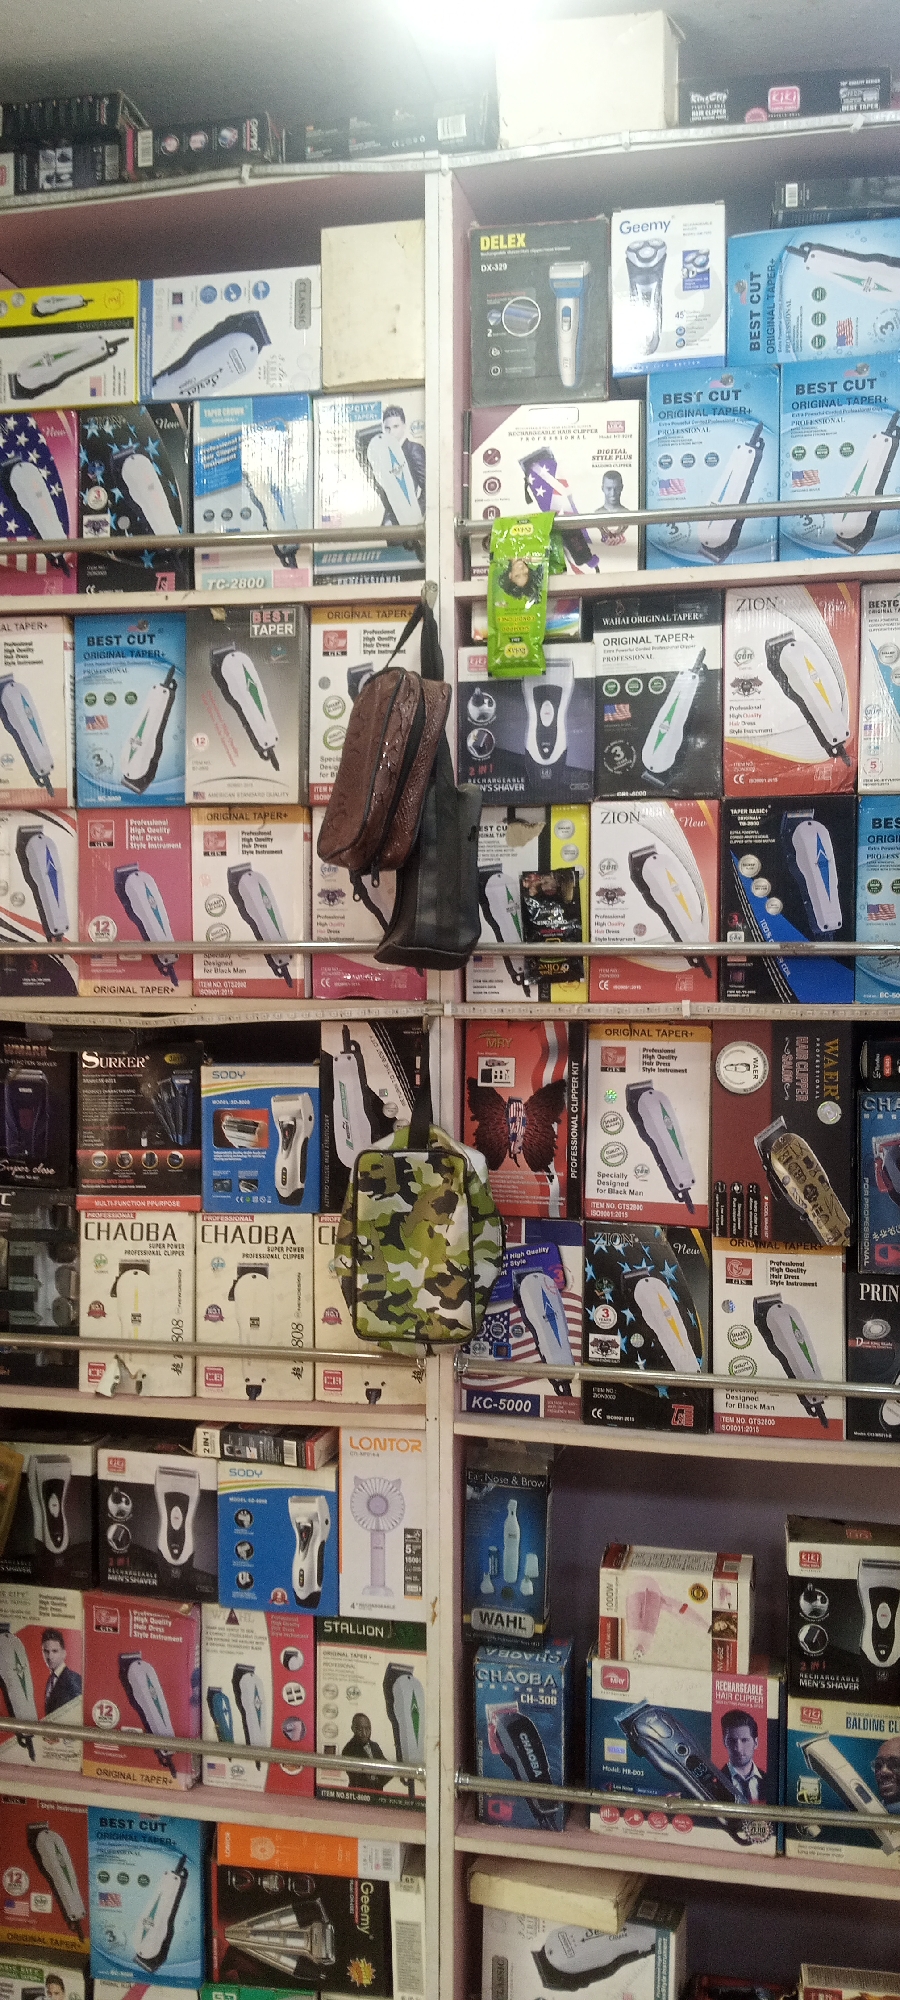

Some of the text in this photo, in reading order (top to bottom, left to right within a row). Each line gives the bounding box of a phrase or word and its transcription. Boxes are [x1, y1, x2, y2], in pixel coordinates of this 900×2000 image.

[619, 220, 671, 235] Geemy
[480, 233, 526, 250] DELEX
[481, 263, 507, 272] DX-329
[750, 272, 761, 351] BEST CUT
[767, 259, 775, 354] ORIGINAL TAPER+
[795, 378, 877, 396] BEST CUT
[662, 389, 742, 405] BEST CUT
[791, 395, 888, 410] ORIGINAL TAPER+
[658, 406, 753, 420] ORIGINAL TAPER+
[155, 418, 180, 430] New
[791, 417, 846, 426] PROFESSIONAL
[322, 551, 382, 564] HIGH QUALITY
[206, 577, 265, 589] TC-2800
[736, 597, 778, 611] ZION
[252, 610, 291, 623] BEST
[327, 609, 414, 620] ORIGINAL TAPER+
[630, 615, 671, 624] ORIGINAL
[15, 622, 48, 631] TAPER+
[252, 624, 294, 636] TAPER
[87, 633, 156, 647] BEST CUT
[602, 633, 695, 647] ORIGINAL TAPER+
[83, 652, 126, 660] ORIGINAL
[602, 654, 654, 663] PROFESSIONAL
[206, 812, 288, 821] ORIGINAL TAPER+
[600, 811, 641, 825] ZION
[679, 816, 708, 828] New
[93, 920, 110, 932] 12
[203, 959, 233, 967] Designed
[93, 986, 175, 994] ORIGINAL TAPER+
[605, 1028, 694, 1038] ORIGINAL TAPER+
[486, 1037, 513, 1048] MRY
[82, 1051, 145, 1069] SURKER
[571, 1061, 579, 1079] KIT
[796, 1036, 809, 1101] HAIR CLIPPER
[823, 1038, 839, 1098] WAER
[212, 1070, 246, 1080] SODY
[571, 1080, 579, 1112] CLIPPER
[597, 1171, 628, 1180] Specially
[597, 1179, 629, 1188] Designed
[607, 1188, 627, 1196] Black
[85, 1222, 177, 1242] CHAOBA
[201, 1225, 297, 1245] CHAOBA
[593, 1232, 636, 1247] ZION
[509, 1247, 550, 1260] High Quality
[673, 1243, 701, 1255] New
[508, 1259, 526, 1267] Style
[769, 1266, 784, 1274] High
[860, 1283, 899, 1302] PRIN
[601, 1308, 610, 1319] 3
[472, 1396, 531, 1413] KC-5000
[725, 1394, 759, 1402] Designed
[349, 1436, 422, 1453] LONTOR
[229, 1468, 263, 1478] SODY
[485, 1473, 546, 1489] Nose Brow
[150, 1617, 172, 1626] Quality
[479, 1611, 526, 1631] WAHL
[323, 1621, 384, 1637] STALLION
[150, 1632, 183, 1643] Instrument
[477, 1669, 558, 1687] CHAOBA
[800, 1673, 860, 1683] RECHARGEABLE
[800, 1679, 859, 1690] MEN'S SHAVER
[715, 1680, 764, 1695] RECHARGEABLE
[520, 1693, 558, 1706] CH-308
[715, 1692, 764, 1704] HAIR CLIPPER
[97, 1704, 113, 1716] 12
[846, 1716, 885, 1732] BALDING
[519, 1732, 542, 1778] CHAOBA
[96, 1768, 173, 1785] ORIGINAL TAPER+
[321, 1790, 334, 1798] ITEM
[99, 1817, 167, 1832] BEST CUT
[96, 1833, 139, 1843] ORIGINAL
[357, 1882, 374, 1935] Geemy
[7, 1933, 46, 1944] ORIGINAL
